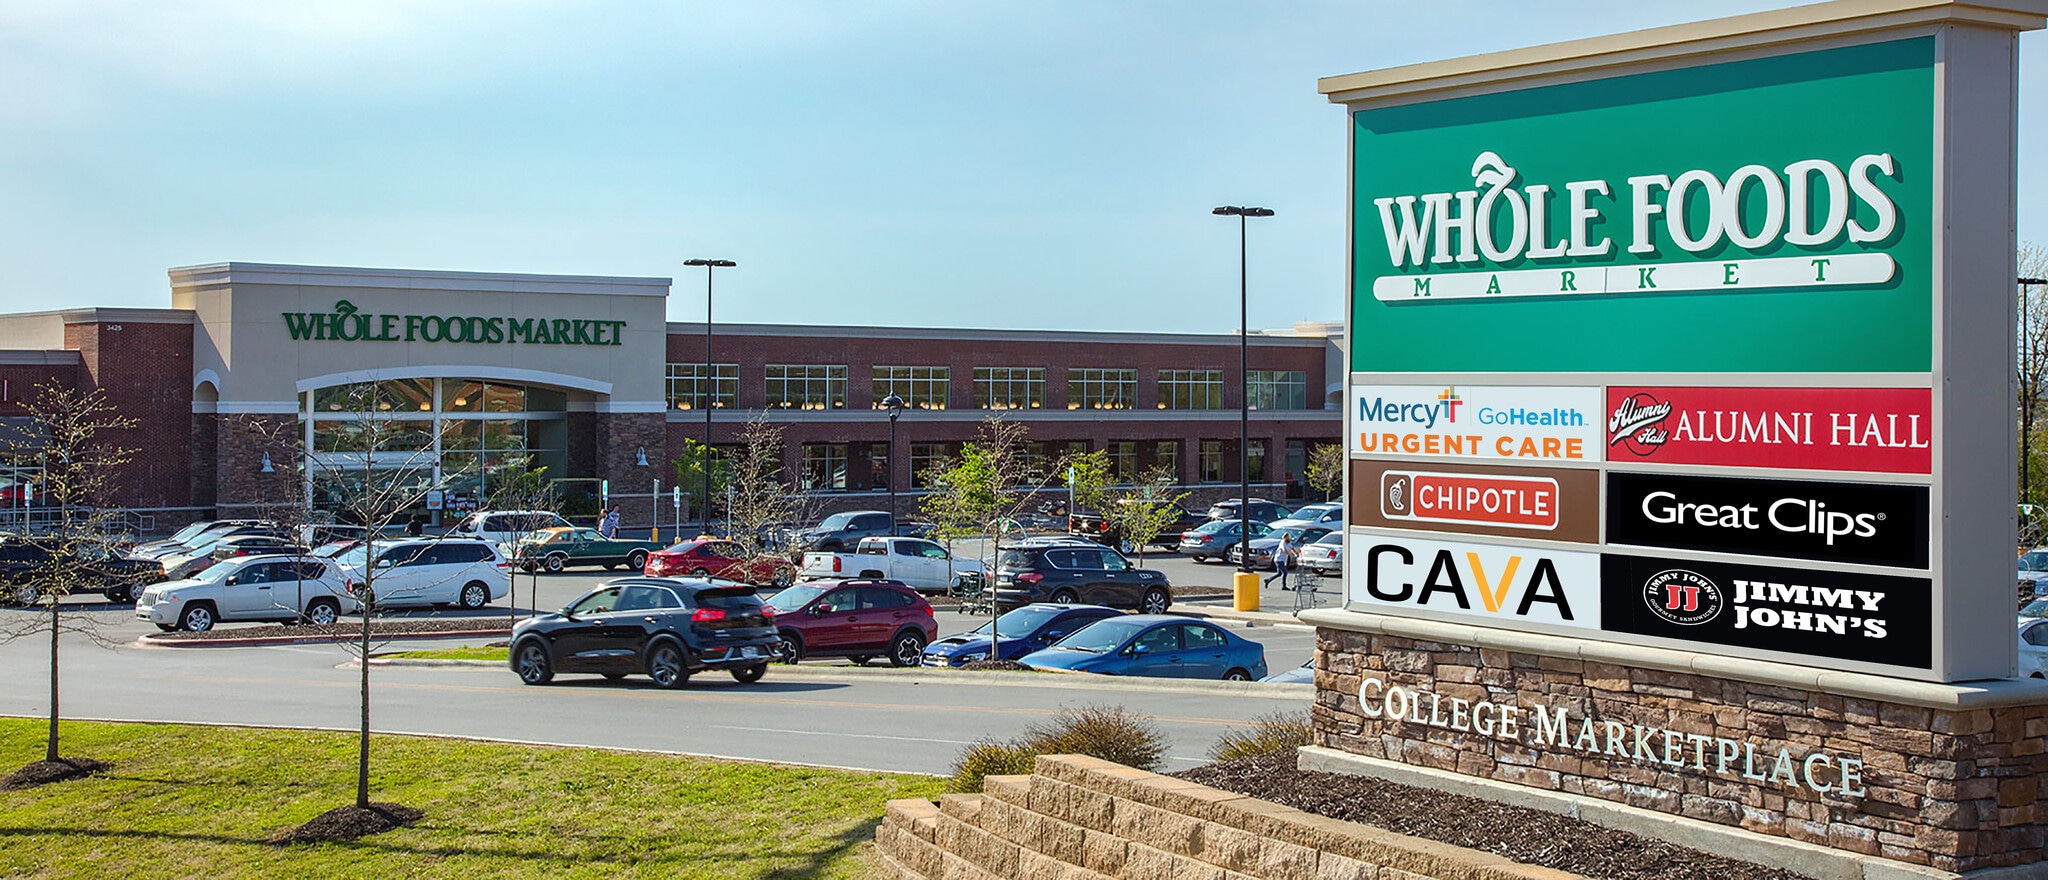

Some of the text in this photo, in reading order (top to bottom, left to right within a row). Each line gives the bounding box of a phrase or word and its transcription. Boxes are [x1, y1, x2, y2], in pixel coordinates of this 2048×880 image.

[1374, 151, 1896, 267] WHOLE FOODS
[1413, 258, 1831, 297] MARKET
[283, 301, 626, 346] WHOLE FOODS MARKET
[1360, 397, 1440, 429] Mercy
[1610, 396, 1671, 433] Alumni
[1361, 432, 1583, 459] URGENT CARE
[1637, 427, 1668, 444] Hall
[1673, 411, 1929, 449] ALUMNI HALL
[1418, 486, 1551, 516] CHIPOTLE
[1641, 491, 1760, 530] Great
[1367, 545, 1574, 620] CAVA
[1648, 573, 1678, 595] JIMMY
[1666, 584, 1700, 612] JJ
[1733, 580, 1885, 609] JIMMY
[1650, 598, 1678, 620] GOURMET
[1734, 606, 1888, 639] JOHN'S
[1358, 678, 1866, 798] COLLEGE MARKETPLACE
